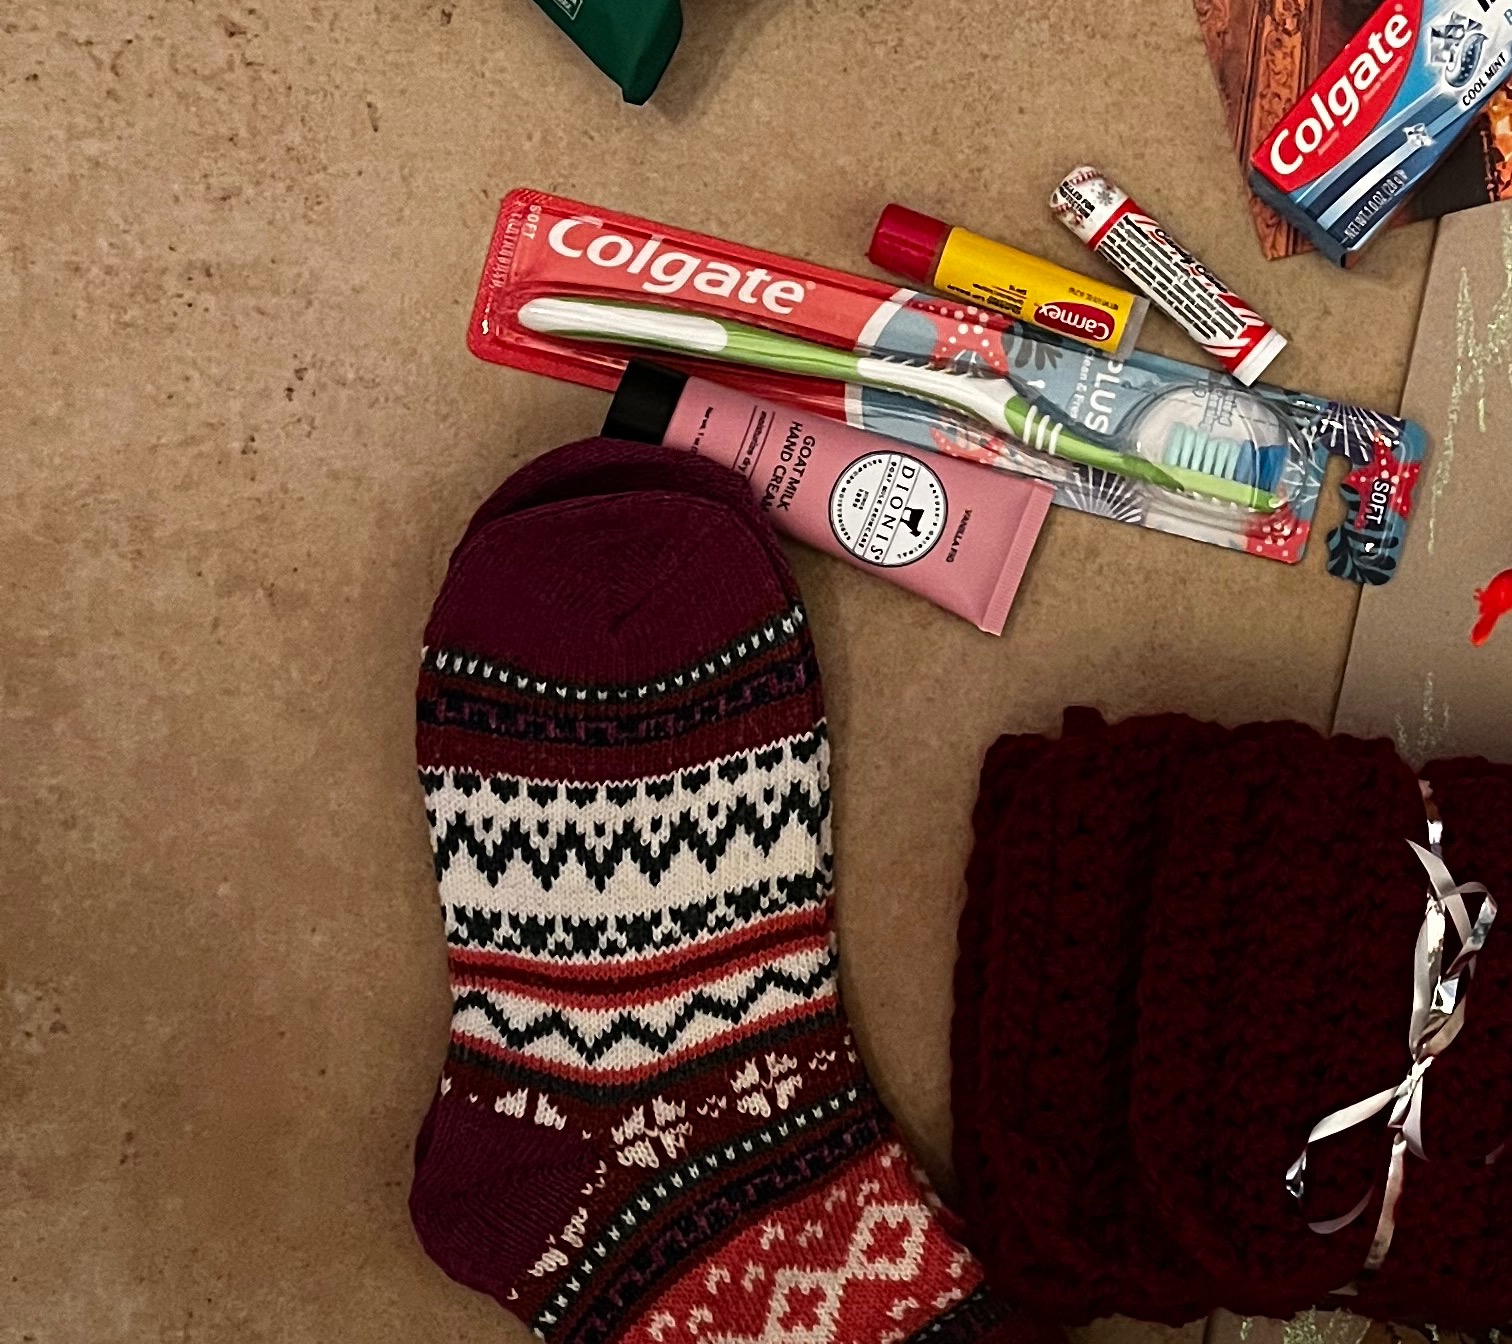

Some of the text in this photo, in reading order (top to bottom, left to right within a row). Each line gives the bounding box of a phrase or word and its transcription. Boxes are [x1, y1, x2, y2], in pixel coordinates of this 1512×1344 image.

[1270, 14, 1412, 175] Colgate
[1462, 52, 1506, 107] COOL MINT
[521, 204, 541, 239] SOFT
[548, 216, 806, 315] Colgate
[1035, 303, 1112, 341] Carmex
[1084, 361, 1122, 432] PLUS
[780, 420, 803, 462] HAND
[775, 435, 815, 511] GOAT MILK
[1366, 479, 1389, 524] SOFT
[870, 465, 915, 556] DIONIS
